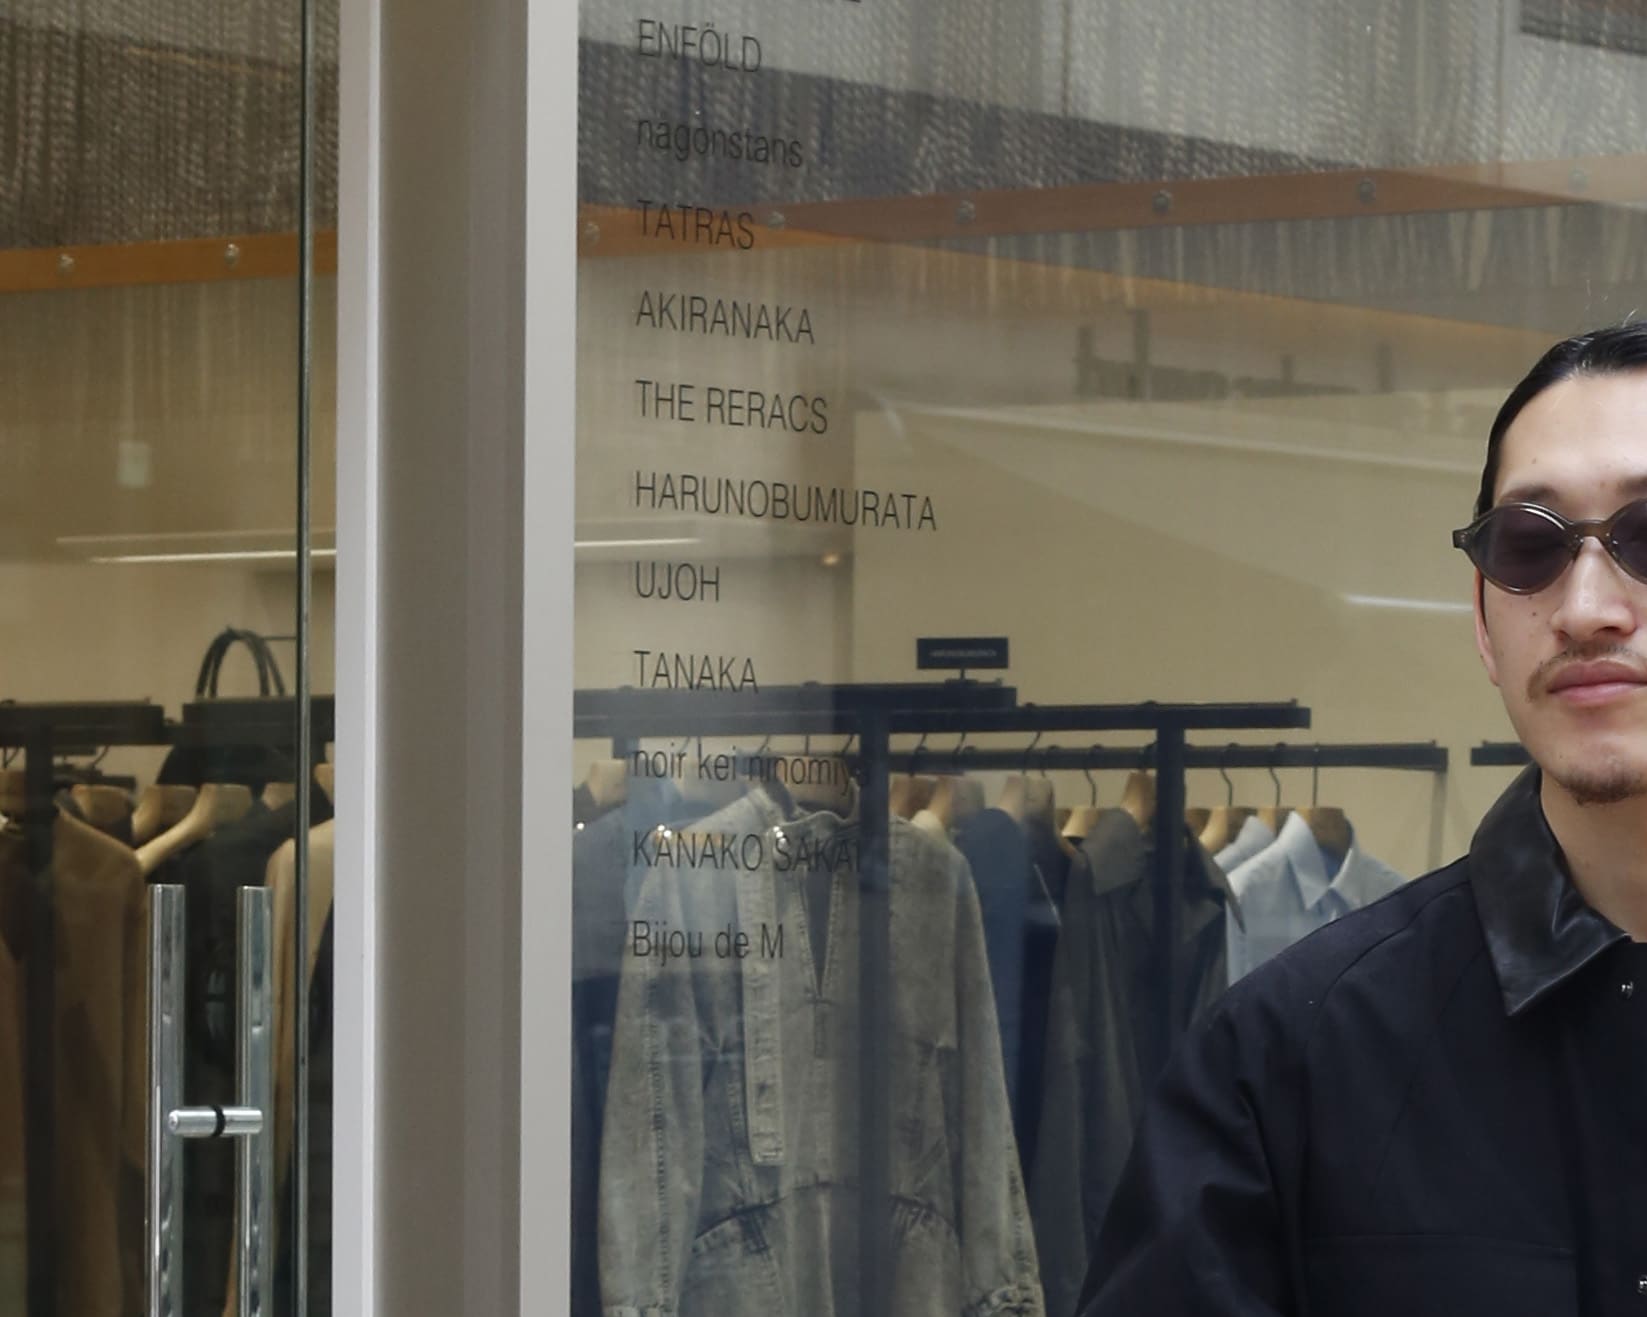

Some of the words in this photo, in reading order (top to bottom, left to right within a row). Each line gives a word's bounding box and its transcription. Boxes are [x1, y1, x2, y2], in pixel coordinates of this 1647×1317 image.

[637, 19, 762, 72] ENFÖLD
[638, 118, 804, 168] nagonstans
[638, 200, 755, 250] TATRAS
[636, 291, 815, 344] AKIRANAKA
[636, 380, 695, 422] THE
[706, 388, 828, 434] RERACS
[636, 470, 937, 531] HARUNOBUMURATA
[635, 561, 720, 602] UJOH
[633, 650, 759, 694] TANAKA
[634, 742, 687, 778] noir
[698, 743, 737, 781] kei
[748, 747, 869, 796] ninomiy
[633, 831, 764, 872] KANAKO
[774, 834, 861, 873] SAKAI
[633, 920, 703, 967] Bijou
[714, 923, 749, 958] de
[760, 921, 785, 959] M
